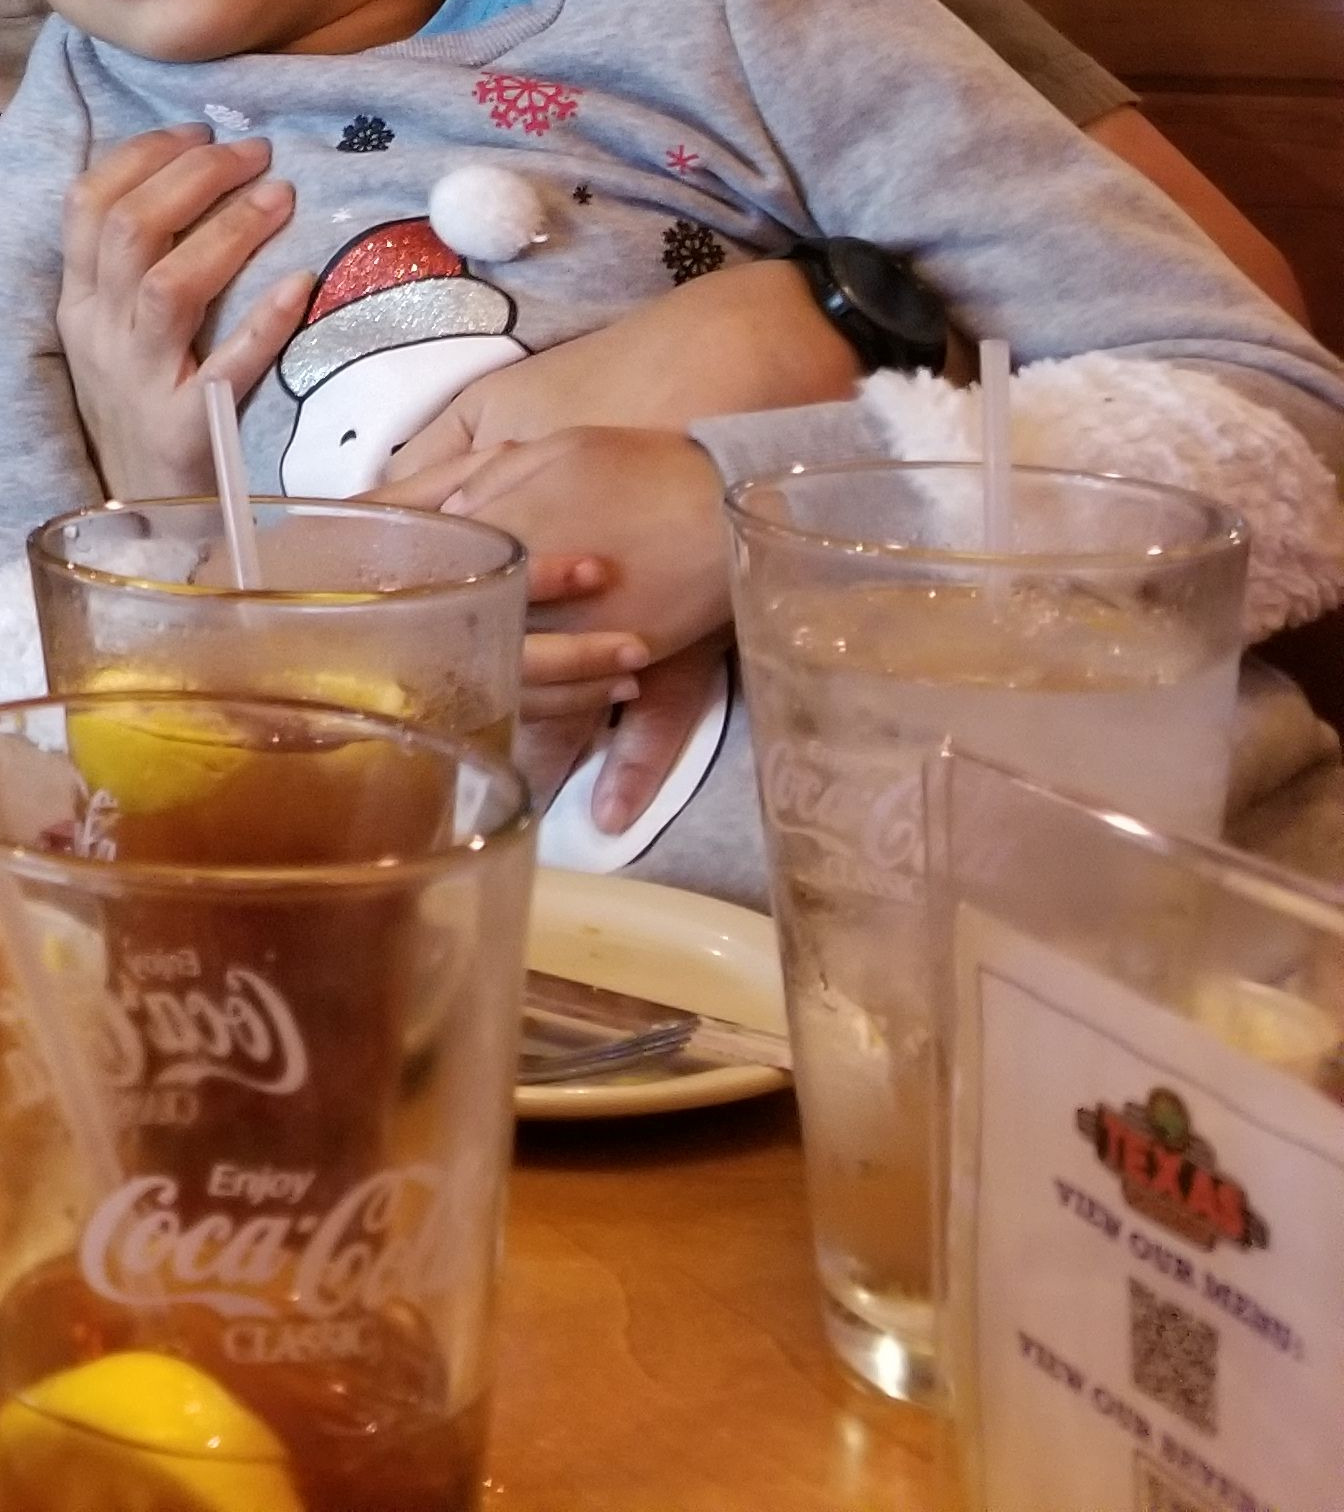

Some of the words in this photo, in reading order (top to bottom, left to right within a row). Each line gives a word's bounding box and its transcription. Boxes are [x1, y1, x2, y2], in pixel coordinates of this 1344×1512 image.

[208, 1163, 315, 1206] Enjoy
[1053, 1174, 1124, 1240] VIEW
[1128, 1229, 1194, 1289] OUR
[1096, 1106, 1249, 1245] TEXAS
[1018, 1327, 1086, 1391] VIEW
[1090, 1385, 1154, 1443] OUR
